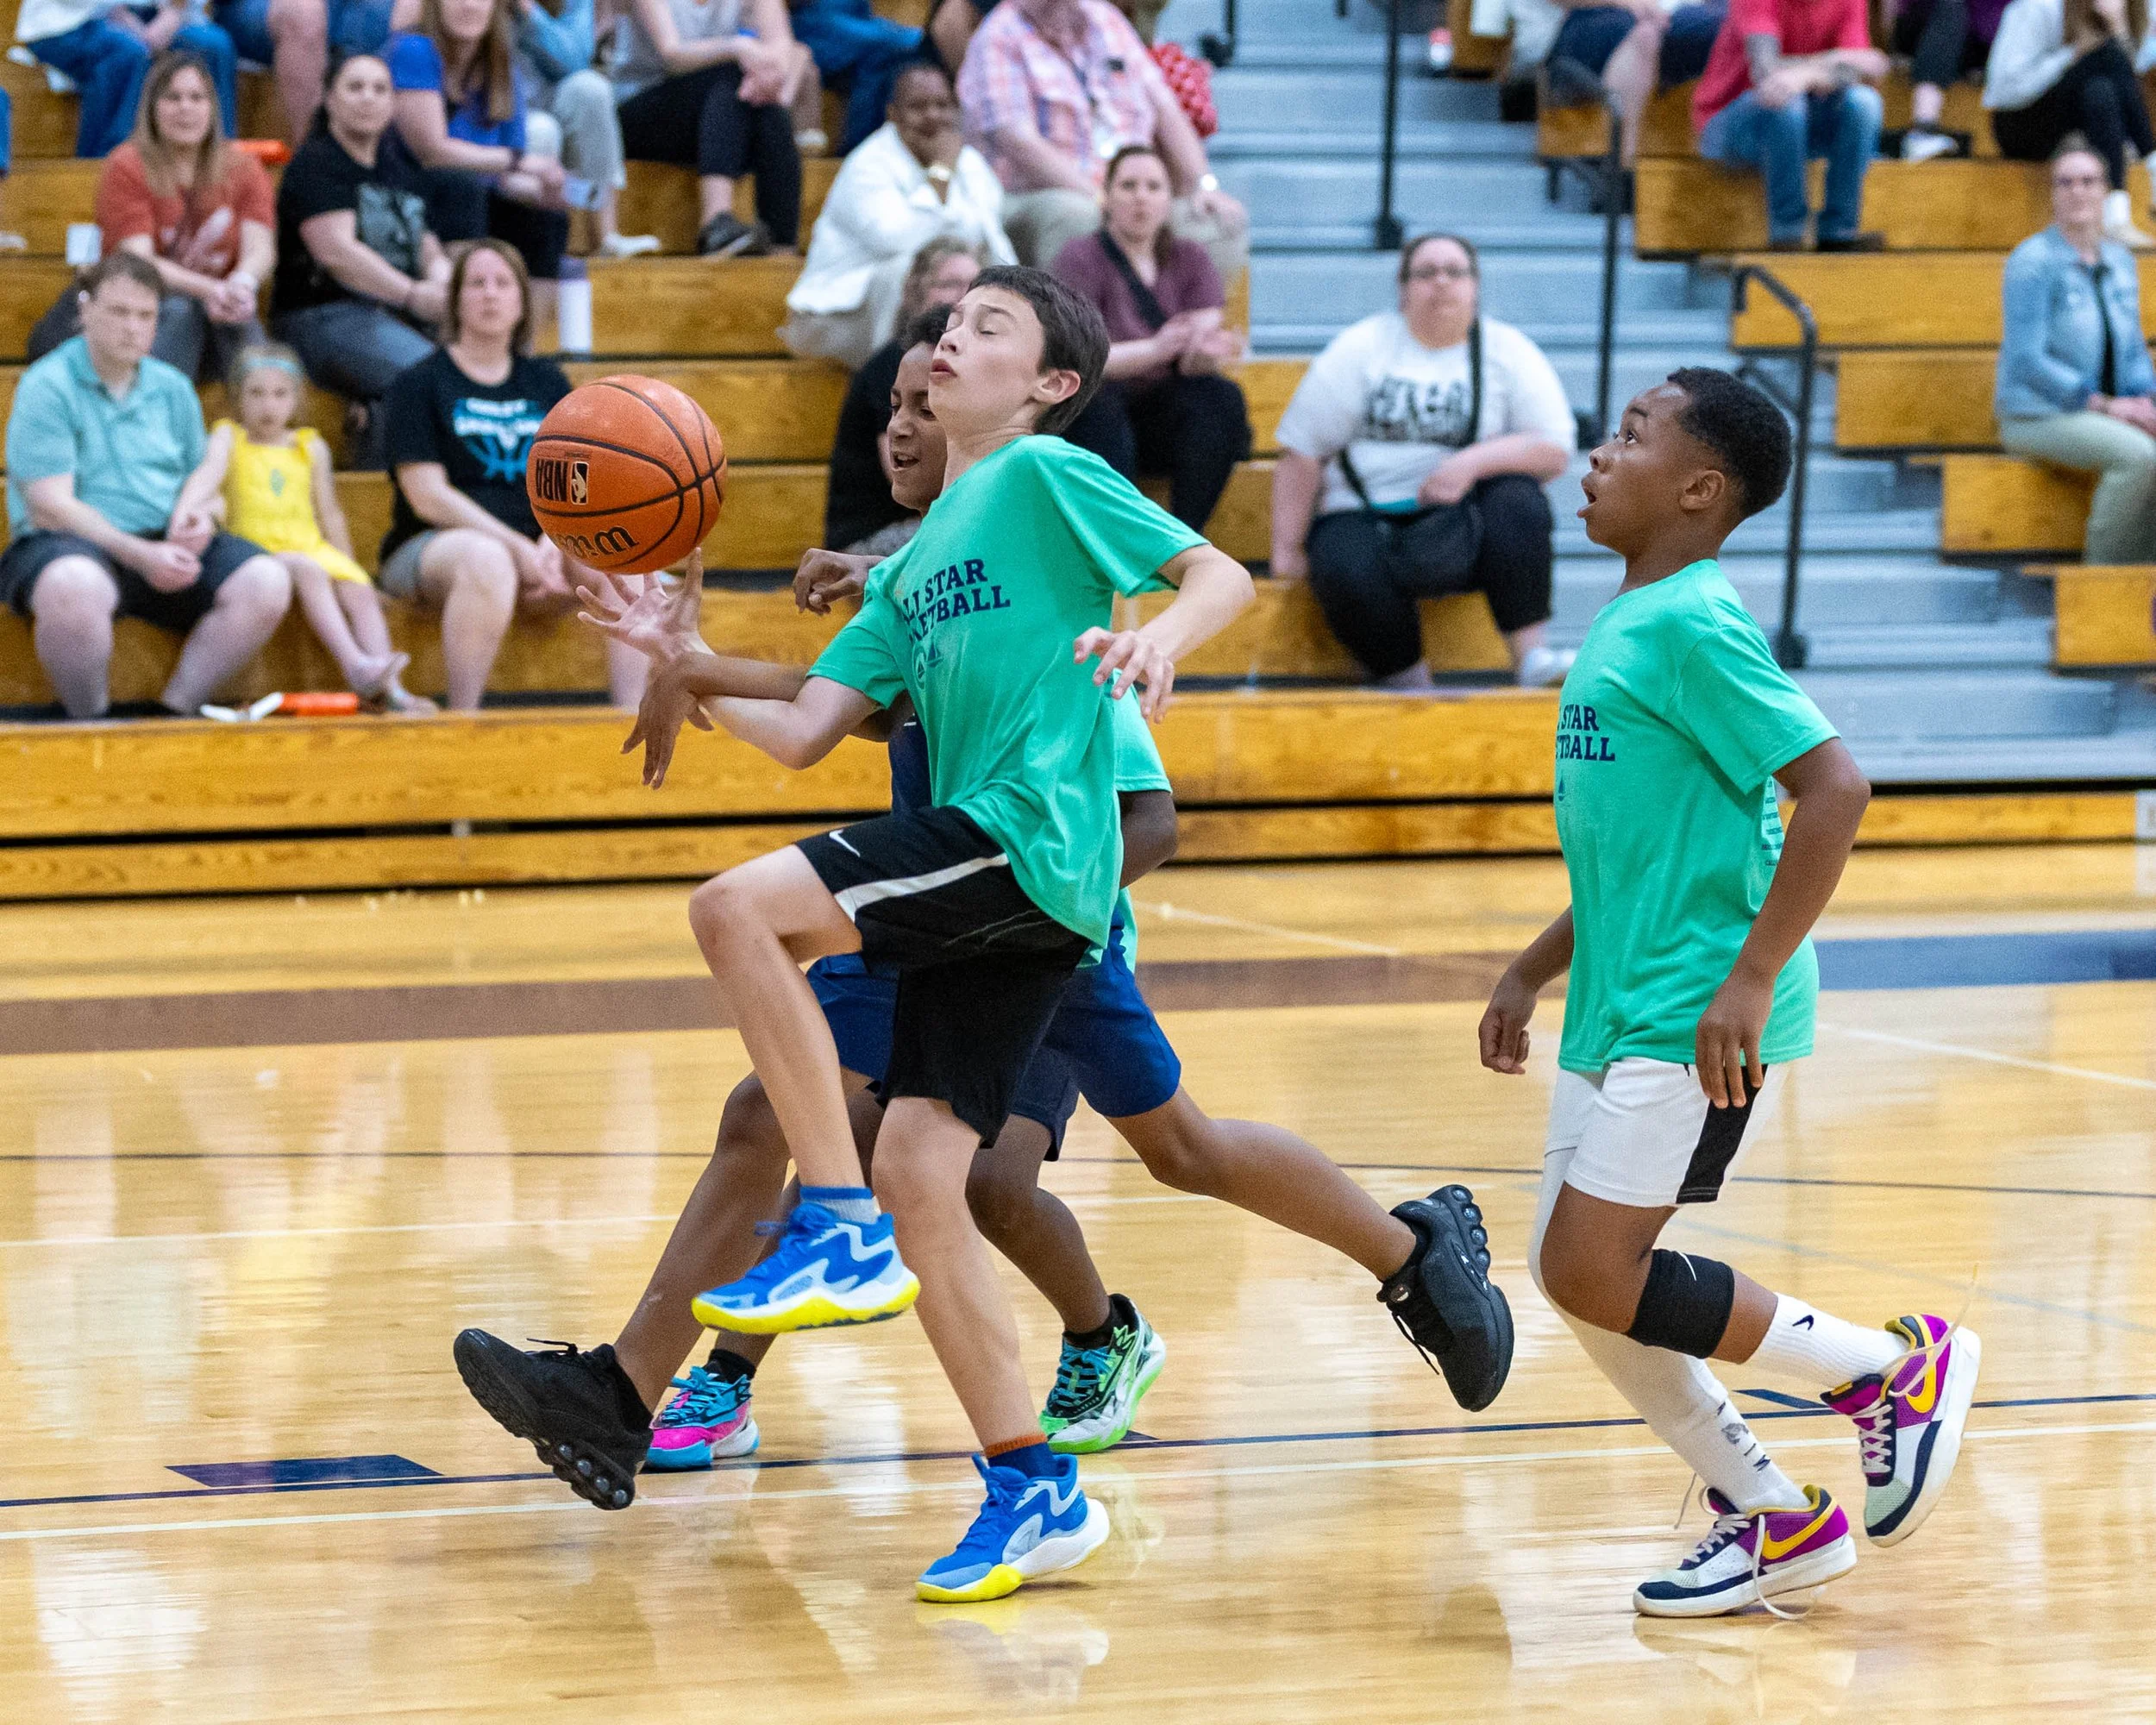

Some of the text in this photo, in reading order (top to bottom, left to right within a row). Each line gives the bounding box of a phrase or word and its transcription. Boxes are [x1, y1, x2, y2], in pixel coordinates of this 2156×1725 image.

[535, 457, 568, 503] NBA
[924, 559, 987, 604] STAR
[1561, 704, 1600, 731] STAR
[1556, 735, 1615, 762] TBALL
